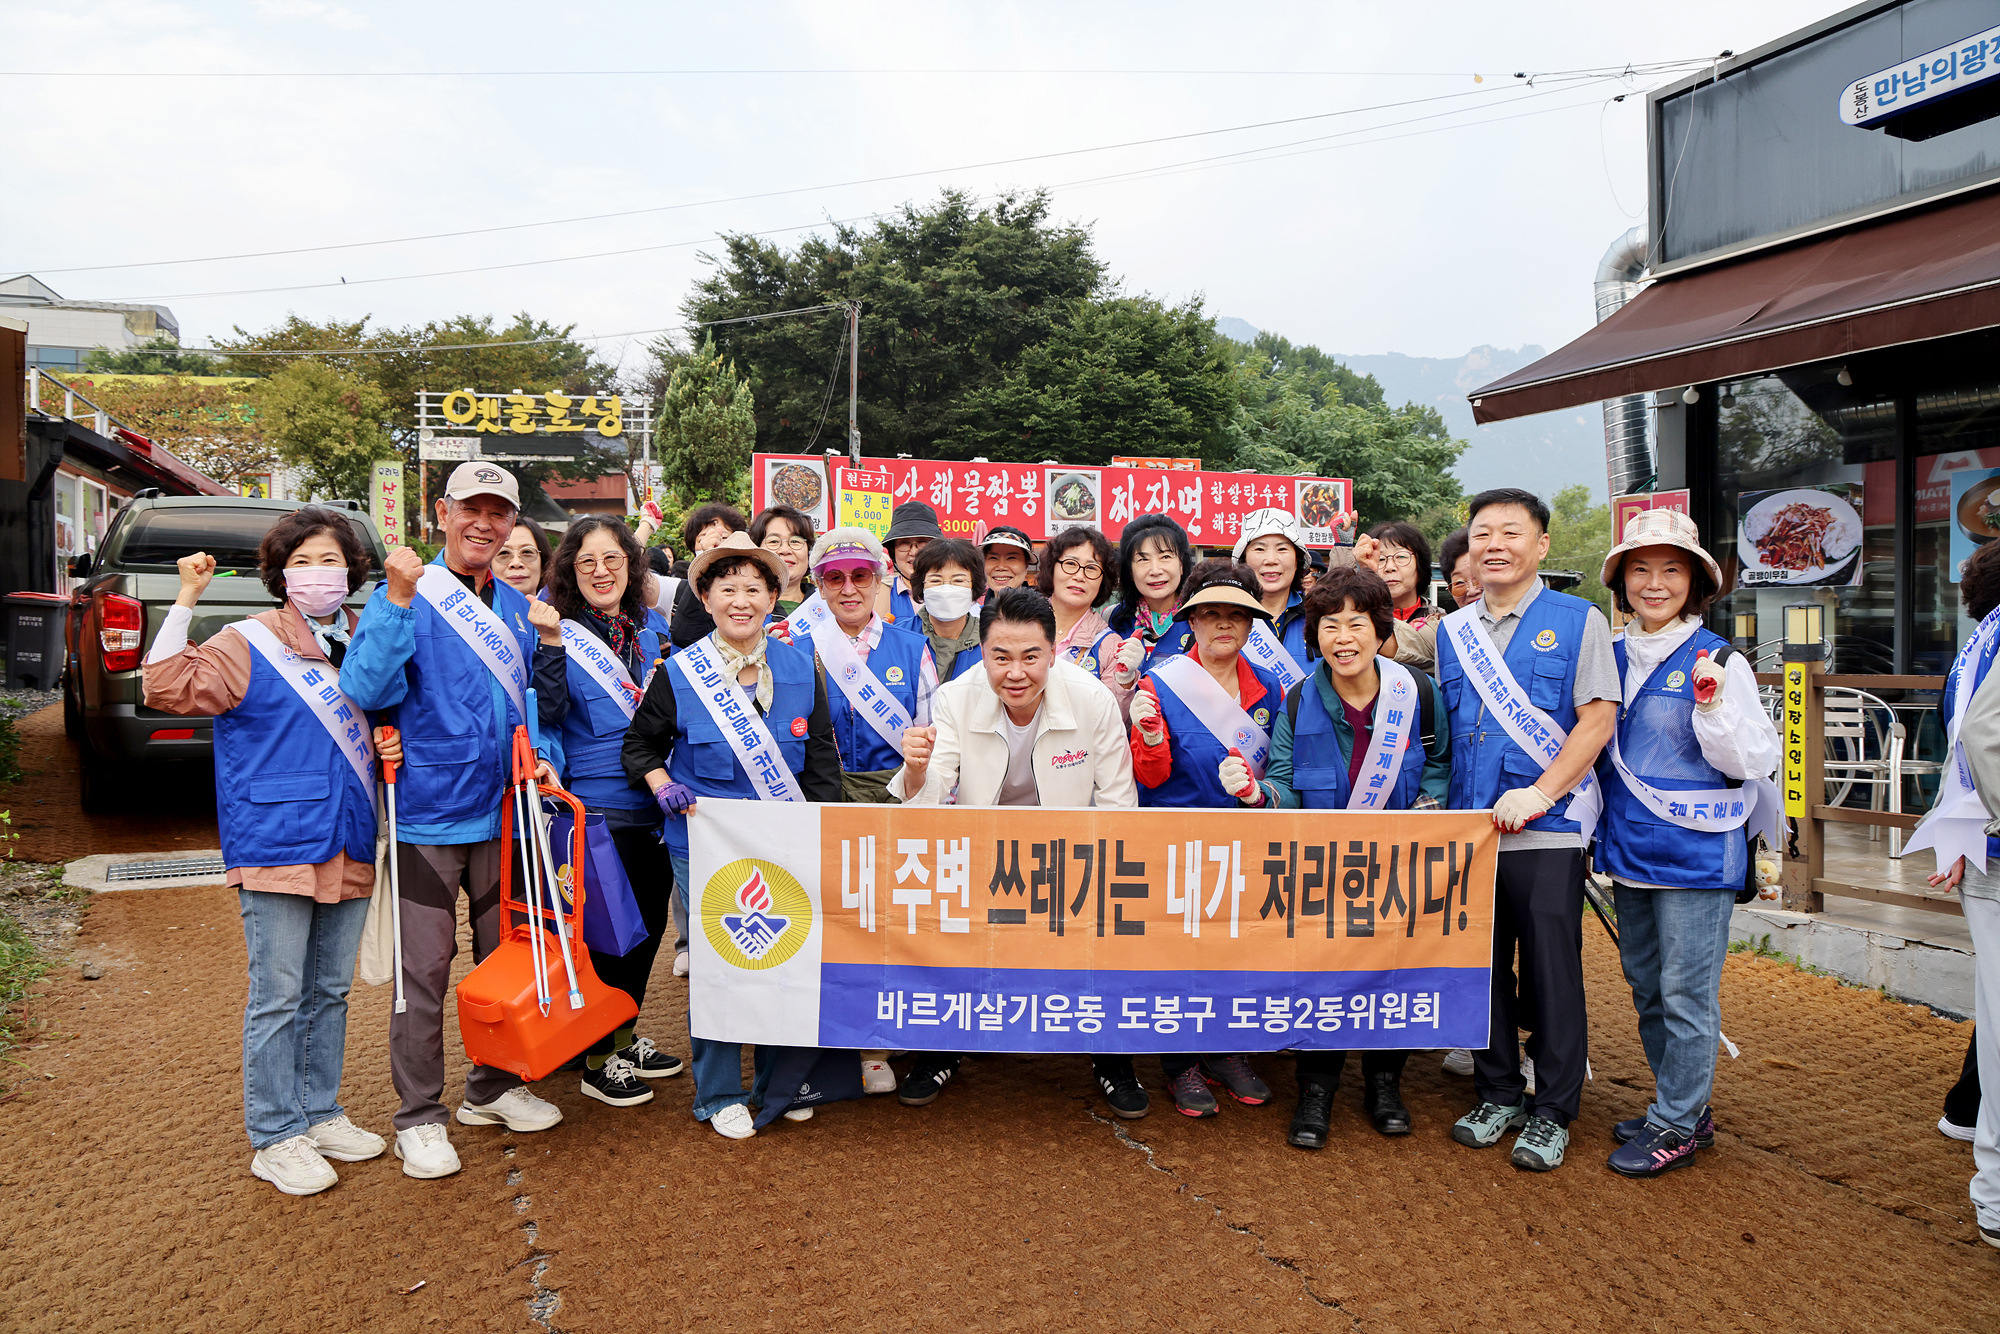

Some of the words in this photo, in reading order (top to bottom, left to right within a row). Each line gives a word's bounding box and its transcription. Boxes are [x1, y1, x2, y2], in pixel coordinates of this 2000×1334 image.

[1854, 81, 1869, 119] 도봉산
[846, 472, 887, 490] 현금가
[1210, 481, 1289, 507] 찹쌀탕수육
[439, 588, 467, 612] 2025
[456, 603, 515, 665] 탄소중립
[684, 643, 722, 689] 천하는
[713, 687, 762, 752] 안전문화
[752, 750, 789, 798] 커지는
[841, 835, 876, 933] 내
[892, 836, 970, 935] 주변
[987, 838, 1149, 938] 쓰레기는
[1166, 840, 1246, 939] 내가
[1259, 840, 1474, 939] 처리합시다!
[877, 990, 1106, 1034] 바르게살기운동
[1117, 995, 1216, 1034] 도봉구
[1227, 991, 1441, 1034] 도봉2동위원회
